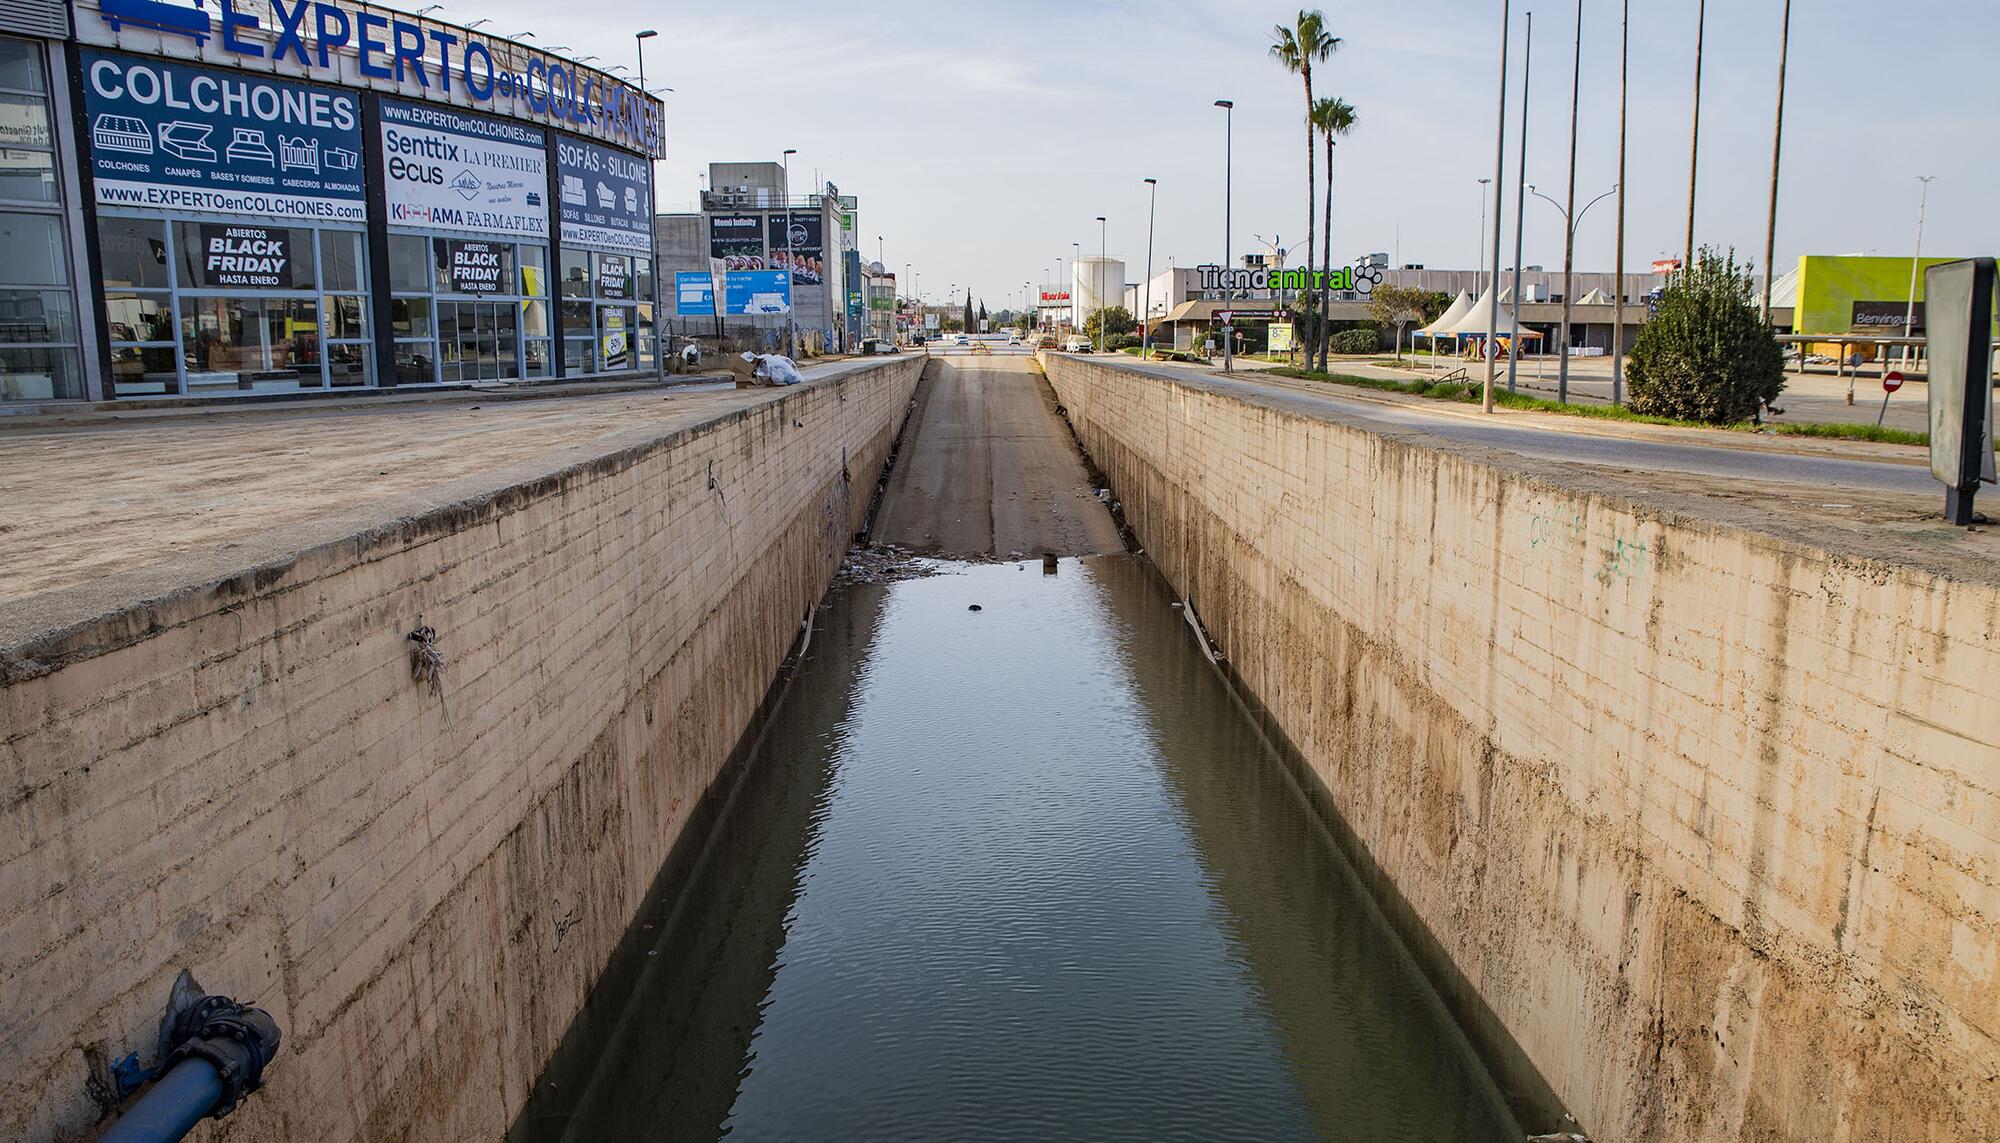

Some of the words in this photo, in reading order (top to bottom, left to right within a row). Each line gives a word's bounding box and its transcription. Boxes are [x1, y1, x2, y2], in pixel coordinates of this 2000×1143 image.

[222, 0, 494, 101] EXPERTO
[90, 60, 355, 131] COLCHONES
[384, 106, 543, 145] www.EXPERTOenCOLCHONES.com
[386, 129, 459, 162] Senttix
[98, 159, 151, 173] COLCHONES
[463, 149, 481, 165] LA
[483, 151, 542, 175] PREMIER
[559, 144, 599, 172] SOFÁS
[608, 156, 647, 184] SILLONE
[165, 166, 202, 178] CANAPÉS
[388, 156, 443, 185] ecus
[210, 171, 234, 182] BASES
[234, 174, 240, 182] Y
[241, 174, 275, 186] SOMIERES
[282, 178, 321, 189] CABECEROS
[324, 182, 360, 193] ALMOHADAS
[100, 187, 364, 219] www.EXPERTOenCOLCHONES.com
[466, 211, 544, 233] FARMAFLEX
[563, 209, 580, 220] SOFÁS
[584, 213, 606, 224] SILLONES
[714, 218, 732, 227] Menú
[733, 217, 757, 227] Infinity
[225, 228, 267, 239] ABIERTOS
[208, 238, 284, 257] BLACK
[464, 243, 489, 252] ABIERTOS
[207, 256, 287, 274] FRIDAY
[454, 252, 498, 267] BLACK
[453, 266, 500, 281] FRIDAY
[601, 263, 624, 277] BLACK
[1197, 264, 1354, 290] Tiendanimal
[219, 273, 249, 285] HASTA
[250, 275, 279, 286] ENERO
[460, 282, 477, 291] HASTA
[478, 283, 497, 291] ENERO
[601, 275, 625, 289] FRIDAY
[1856, 313, 1917, 327] Benvingus
